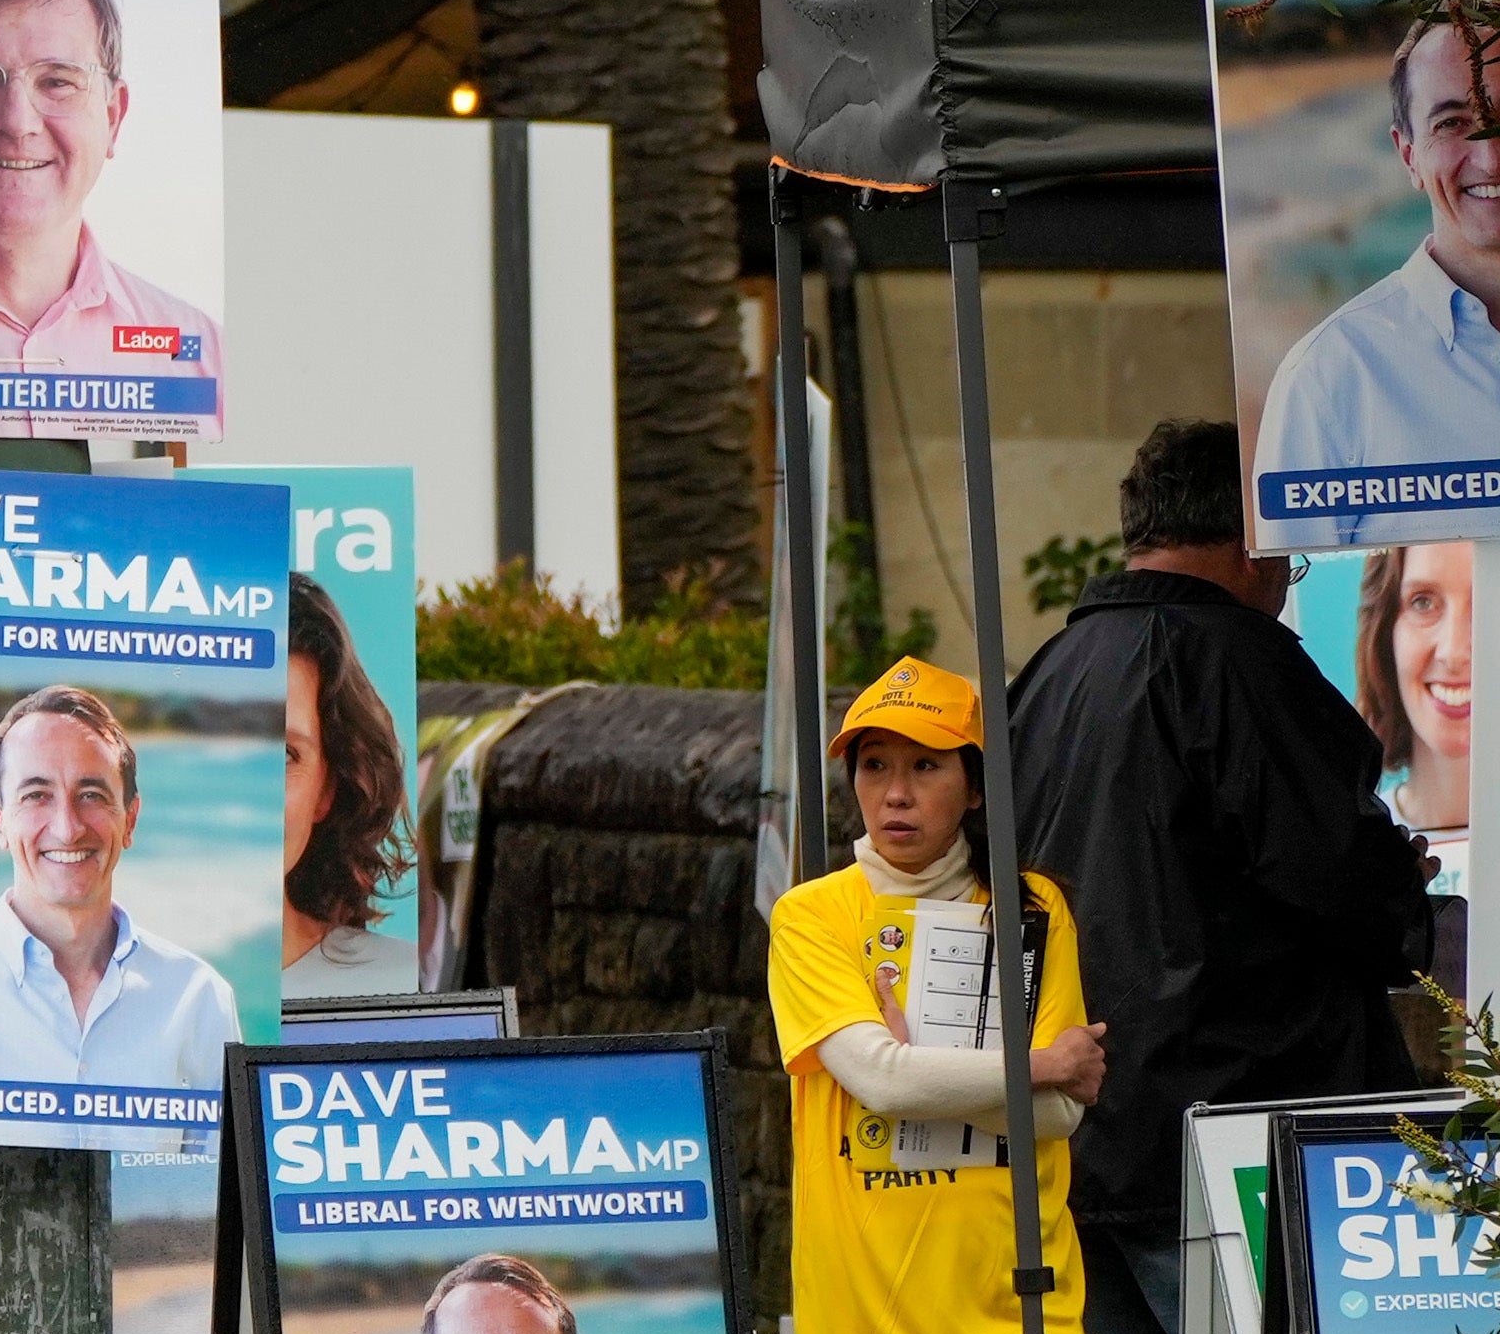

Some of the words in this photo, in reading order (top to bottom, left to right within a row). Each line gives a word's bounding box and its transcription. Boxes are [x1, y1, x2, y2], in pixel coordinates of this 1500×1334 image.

[118, 331, 173, 350] Labor
[54, 381, 155, 409] FUTURE
[214, 585, 273, 618] MP
[3, 624, 57, 650] FOR
[65, 629, 253, 661] WENTWORTH
[875, 700, 914, 710] AUSTRALIA
[917, 703, 942, 715] PARTY
[882, 691, 904, 701] VOTE
[73, 1094, 223, 1123] DELIVERIN
[268, 1069, 451, 1120] DAVE
[272, 1117, 636, 1184] SHARMA
[637, 1139, 700, 1172] MP
[864, 1169, 957, 1191] PARTY
[298, 1200, 417, 1225] LIBERAL
[424, 1196, 482, 1222] FOR
[485, 1191, 684, 1220] WENTWORTH
